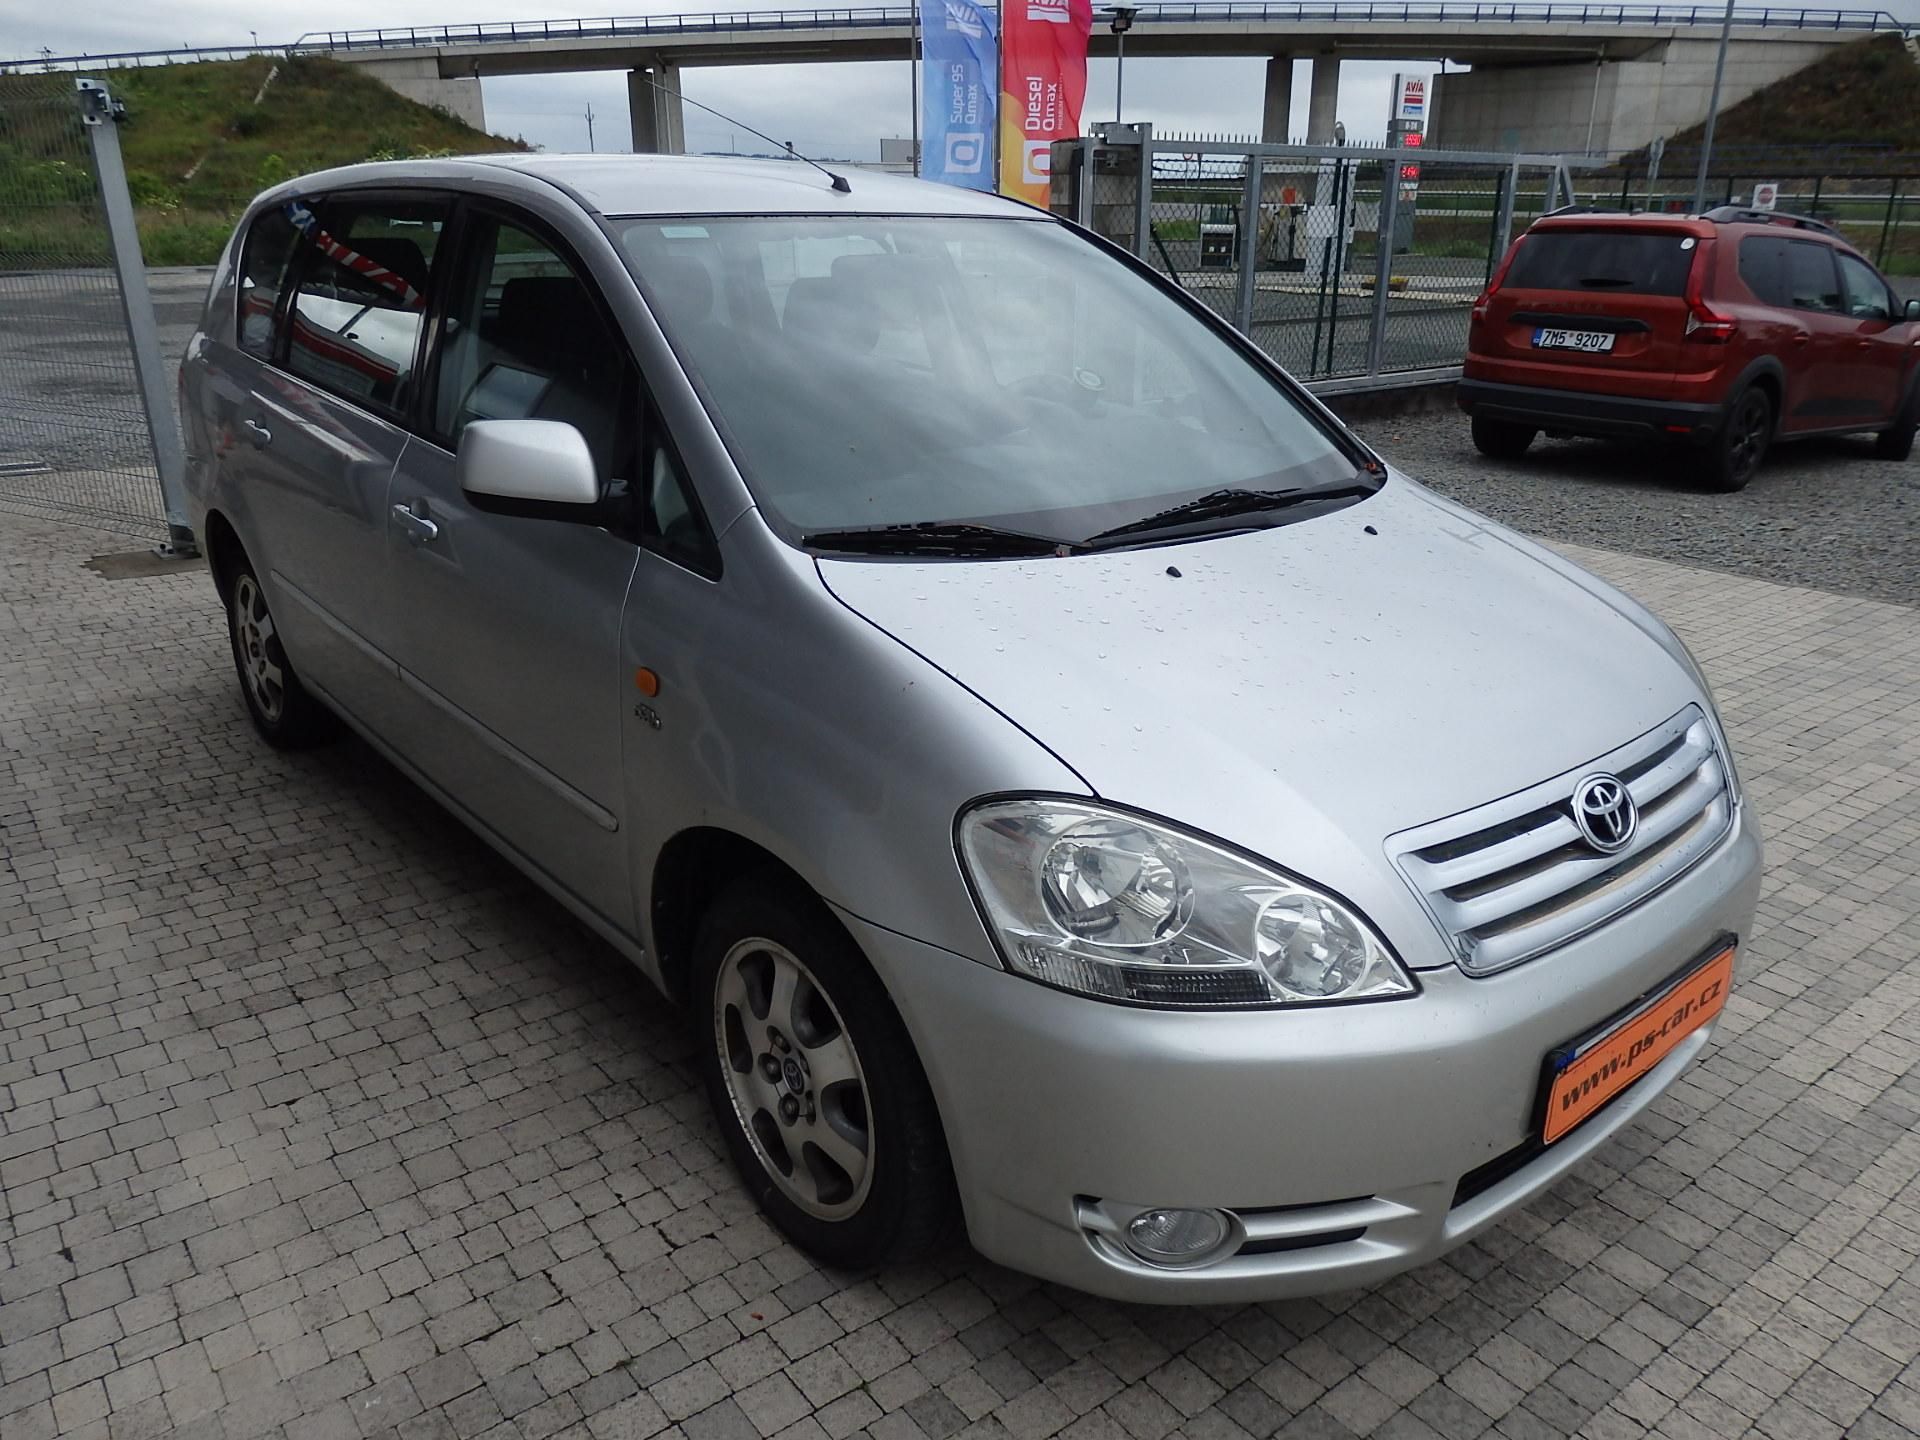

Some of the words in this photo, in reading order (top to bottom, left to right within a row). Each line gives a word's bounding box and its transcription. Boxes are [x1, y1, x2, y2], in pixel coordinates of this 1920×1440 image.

[952, 64, 963, 83] 95
[1405, 80, 1424, 93] AVIA
[951, 88, 966, 124] Super
[965, 84, 978, 124] Qmax
[1025, 77, 1043, 131] Diesel
[1043, 83, 1057, 131] Qmax
[1542, 330, 1567, 345] 7M5
[1574, 333, 1609, 348] 9207
[1561, 979, 1722, 1112] www.ps-car.cz
